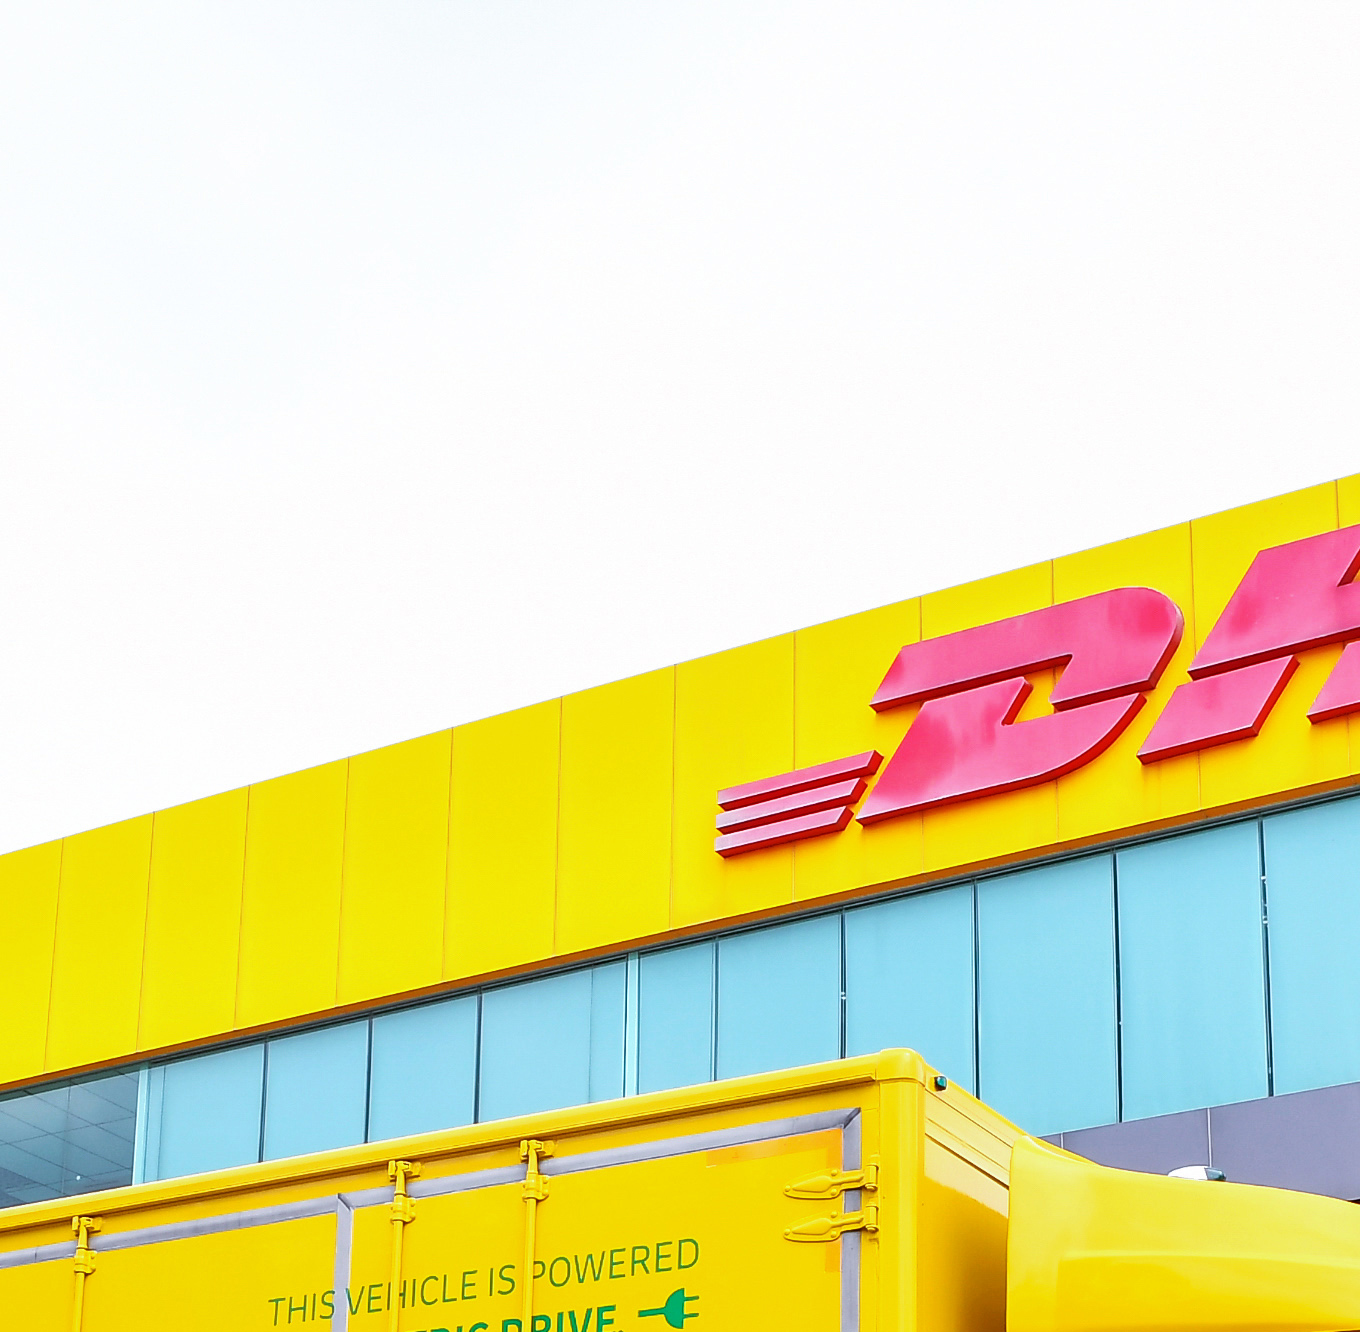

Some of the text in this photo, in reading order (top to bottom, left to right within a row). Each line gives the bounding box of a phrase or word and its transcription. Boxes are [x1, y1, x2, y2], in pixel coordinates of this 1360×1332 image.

[268, 1237, 700, 1327] THIS VEHICLE IS POWERED
